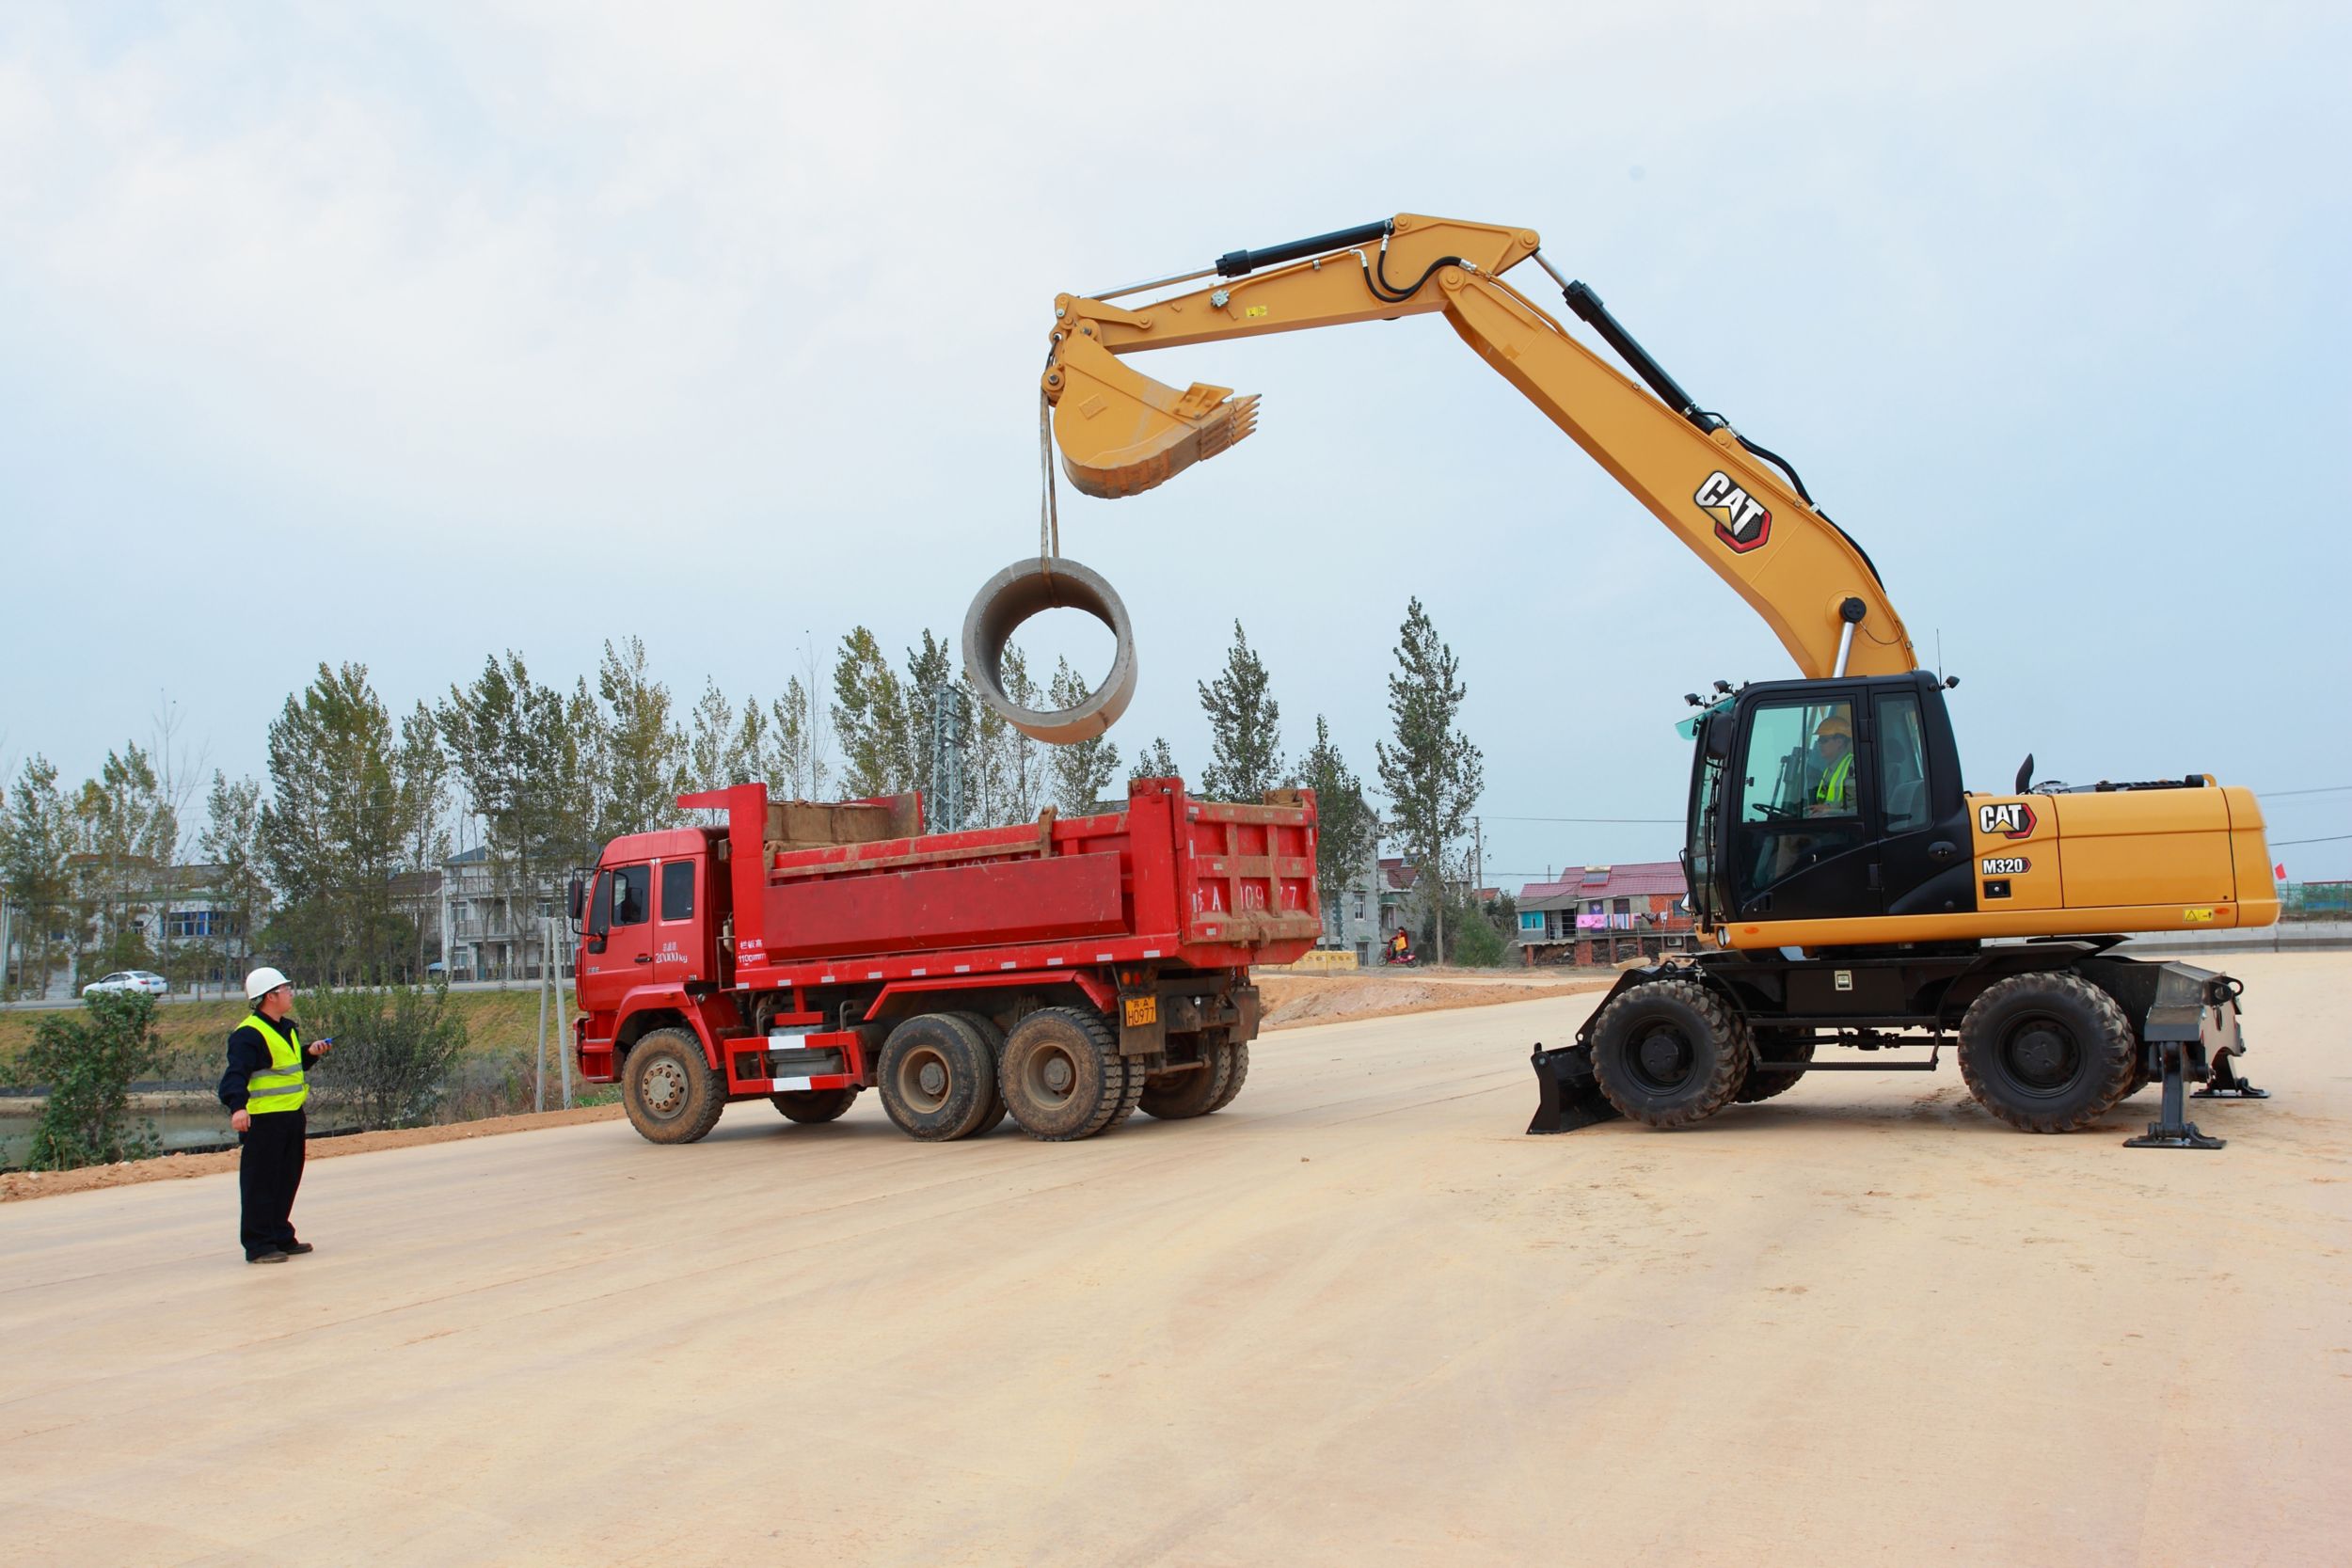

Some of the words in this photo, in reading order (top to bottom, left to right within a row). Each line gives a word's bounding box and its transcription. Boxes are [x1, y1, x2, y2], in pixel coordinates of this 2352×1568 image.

[1695, 471, 1766, 536] CAT
[1979, 804, 2022, 833] CAT
[1982, 858, 2023, 874] M320
[1128, 1006, 1154, 1025] H0977
